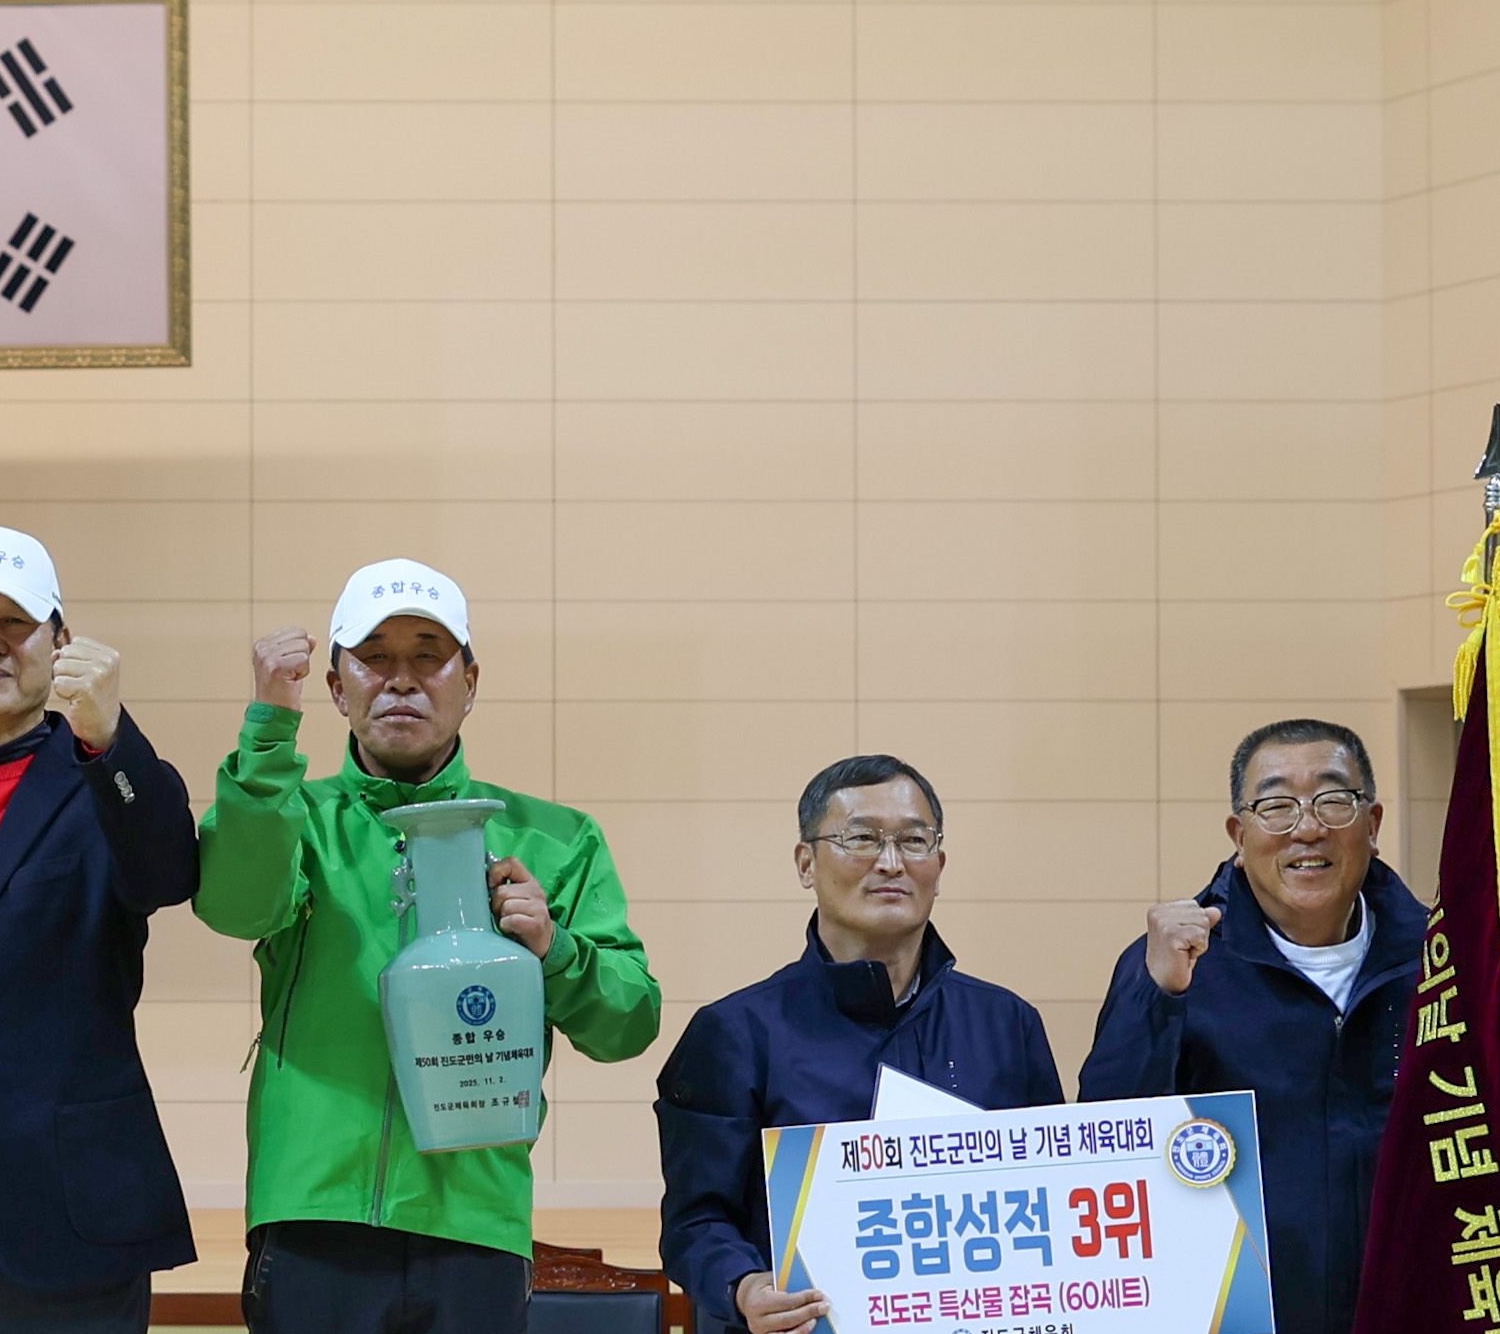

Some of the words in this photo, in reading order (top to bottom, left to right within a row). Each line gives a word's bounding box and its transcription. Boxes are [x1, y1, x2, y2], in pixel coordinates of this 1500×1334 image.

[372, 580, 440, 600] 종합우승
[415, 1056, 438, 1067] 제50회
[441, 1053, 483, 1067] 진도군민의
[485, 1052, 493, 1063] 날
[452, 1032, 475, 1045] 종합
[483, 1029, 505, 1042] 우승
[841, 1134, 902, 1172] 제50회
[909, 1128, 1002, 1167] 진도군민의
[1009, 1128, 1027, 1157] 날
[1035, 1123, 1071, 1155] 기념
[1078, 1118, 1153, 1152] 체육대회
[1424, 1066, 1499, 1182] 기념
[855, 1187, 1053, 1280] 종합성적
[1069, 1180, 1153, 1259] 3위
[868, 1291, 932, 1326] 진도군
[938, 1285, 1002, 1320] 특산물
[1008, 1282, 1052, 1315] 잡곡
[1058, 1276, 1150, 1313] (60세트)
